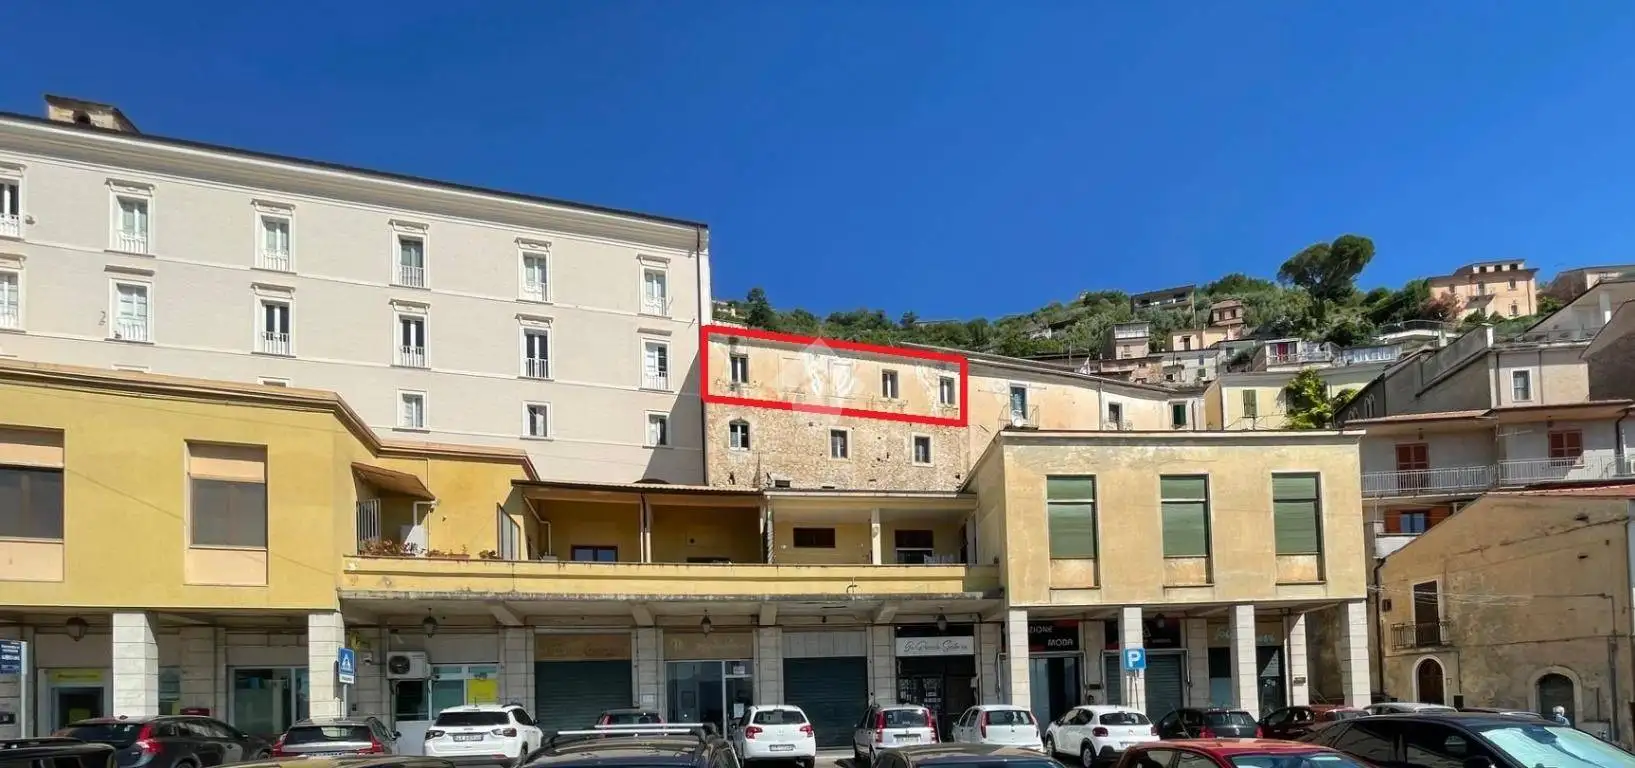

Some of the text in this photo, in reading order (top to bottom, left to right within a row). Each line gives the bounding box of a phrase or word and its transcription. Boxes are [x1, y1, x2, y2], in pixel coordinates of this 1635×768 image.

[1029, 625, 1053, 633] ZIONE
[1047, 638, 1074, 647] MODA
[1128, 650, 1141, 668] P
